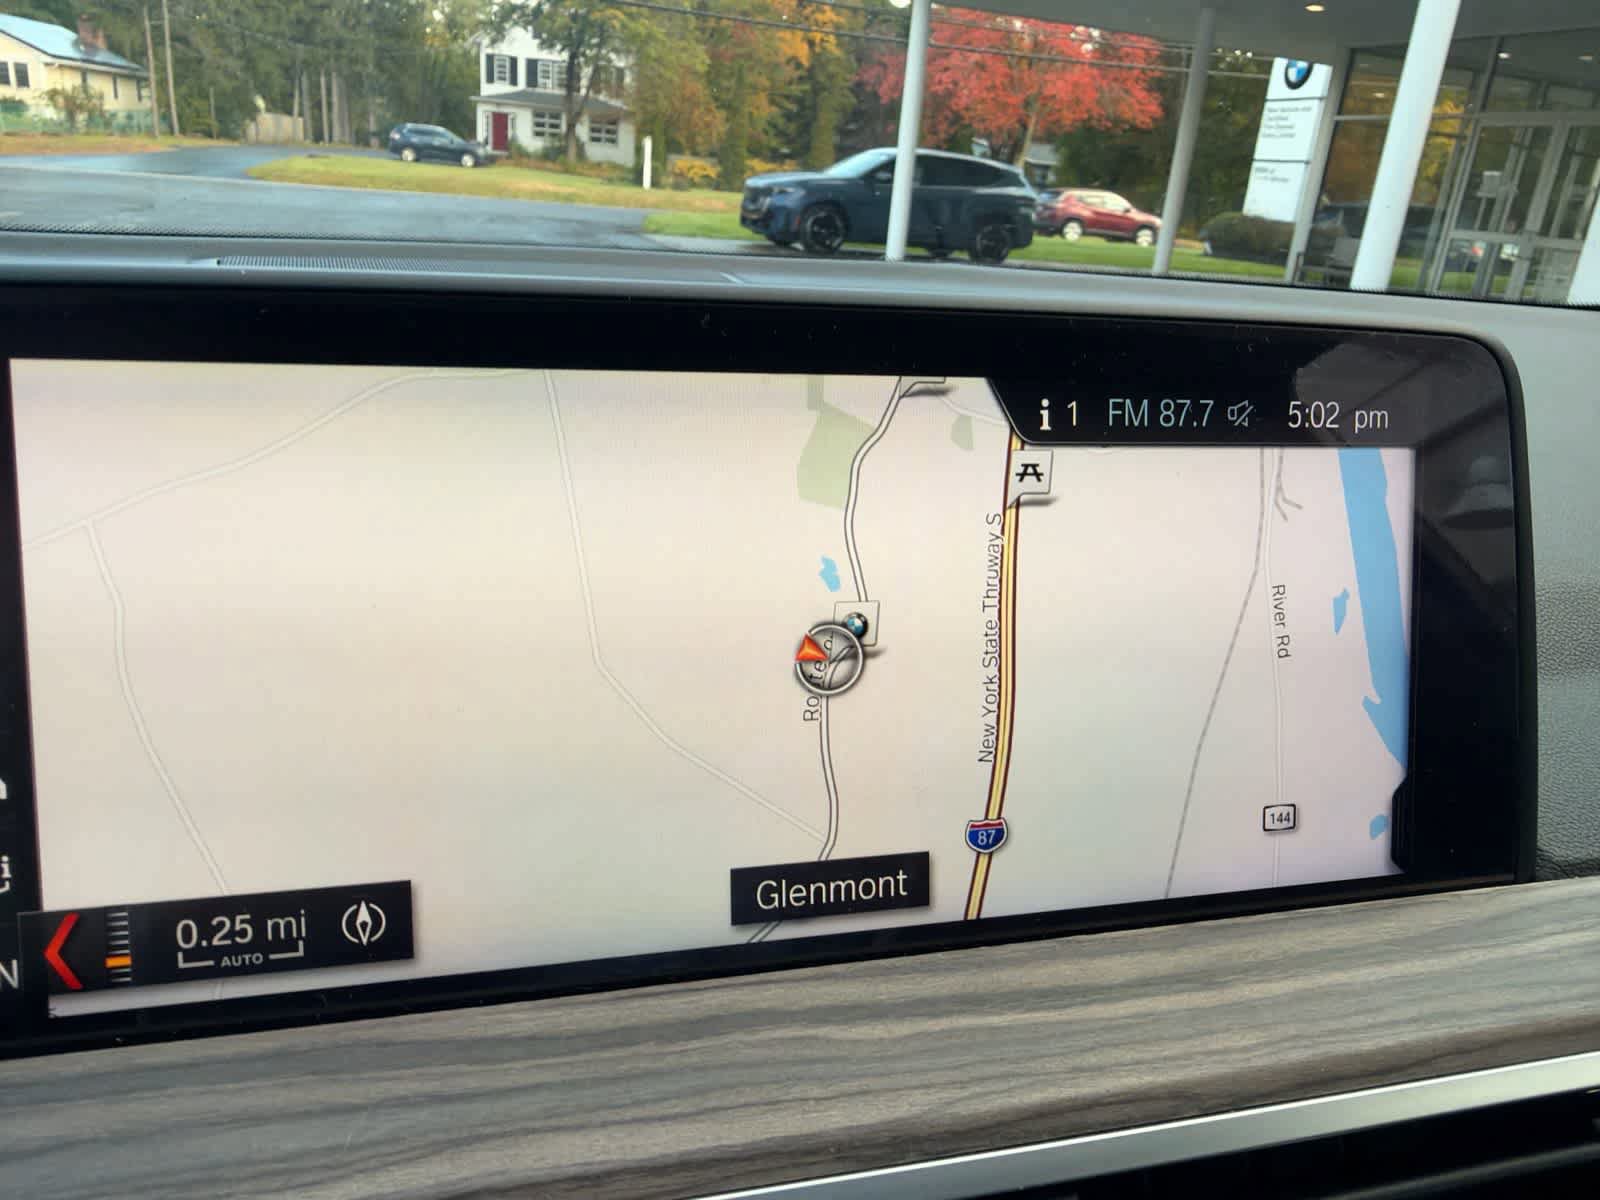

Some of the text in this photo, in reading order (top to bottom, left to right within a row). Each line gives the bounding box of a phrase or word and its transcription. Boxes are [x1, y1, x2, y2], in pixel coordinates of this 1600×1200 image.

[1066, 400, 1078, 427] 1
[1108, 398, 1214, 428] FM 87.7
[1287, 400, 1390, 434] 5:02 pm
[978, 512, 1004, 763] New York State Thruway S
[1271, 584, 1292, 659] River Rd
[1270, 811, 1291, 825] 144
[977, 830, 997, 846] 87
[756, 868, 909, 911] Glenmont
[176, 909, 307, 949] 0.25 mi
[220, 952, 264, 967] AUTO
